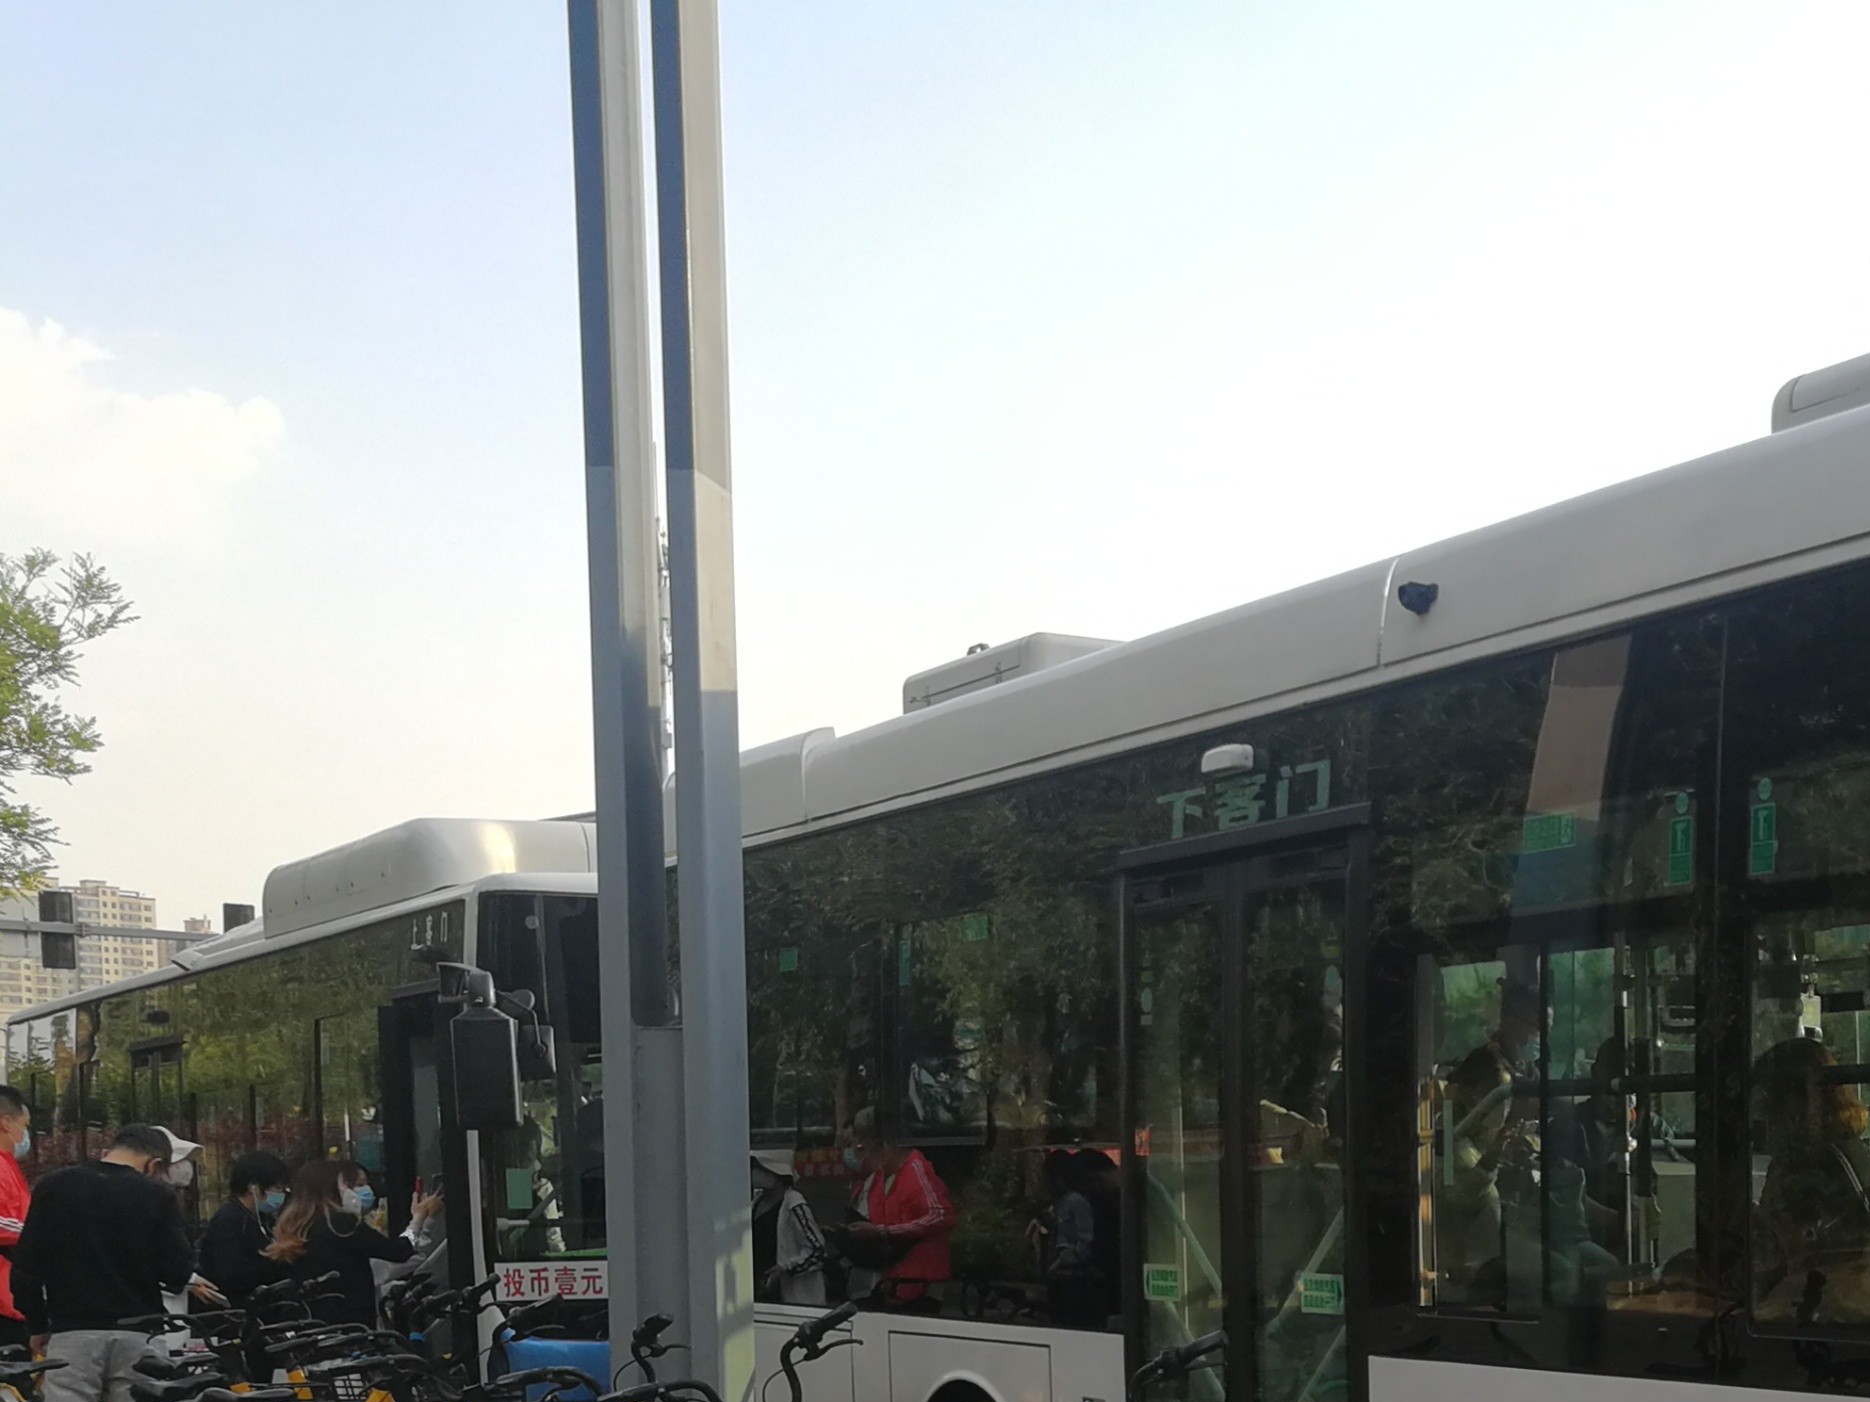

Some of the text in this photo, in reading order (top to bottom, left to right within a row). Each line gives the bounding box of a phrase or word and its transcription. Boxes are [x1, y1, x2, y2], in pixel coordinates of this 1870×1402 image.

[1156, 759, 1331, 839] 下客门
[504, 1266, 604, 1298] 投币壹元
